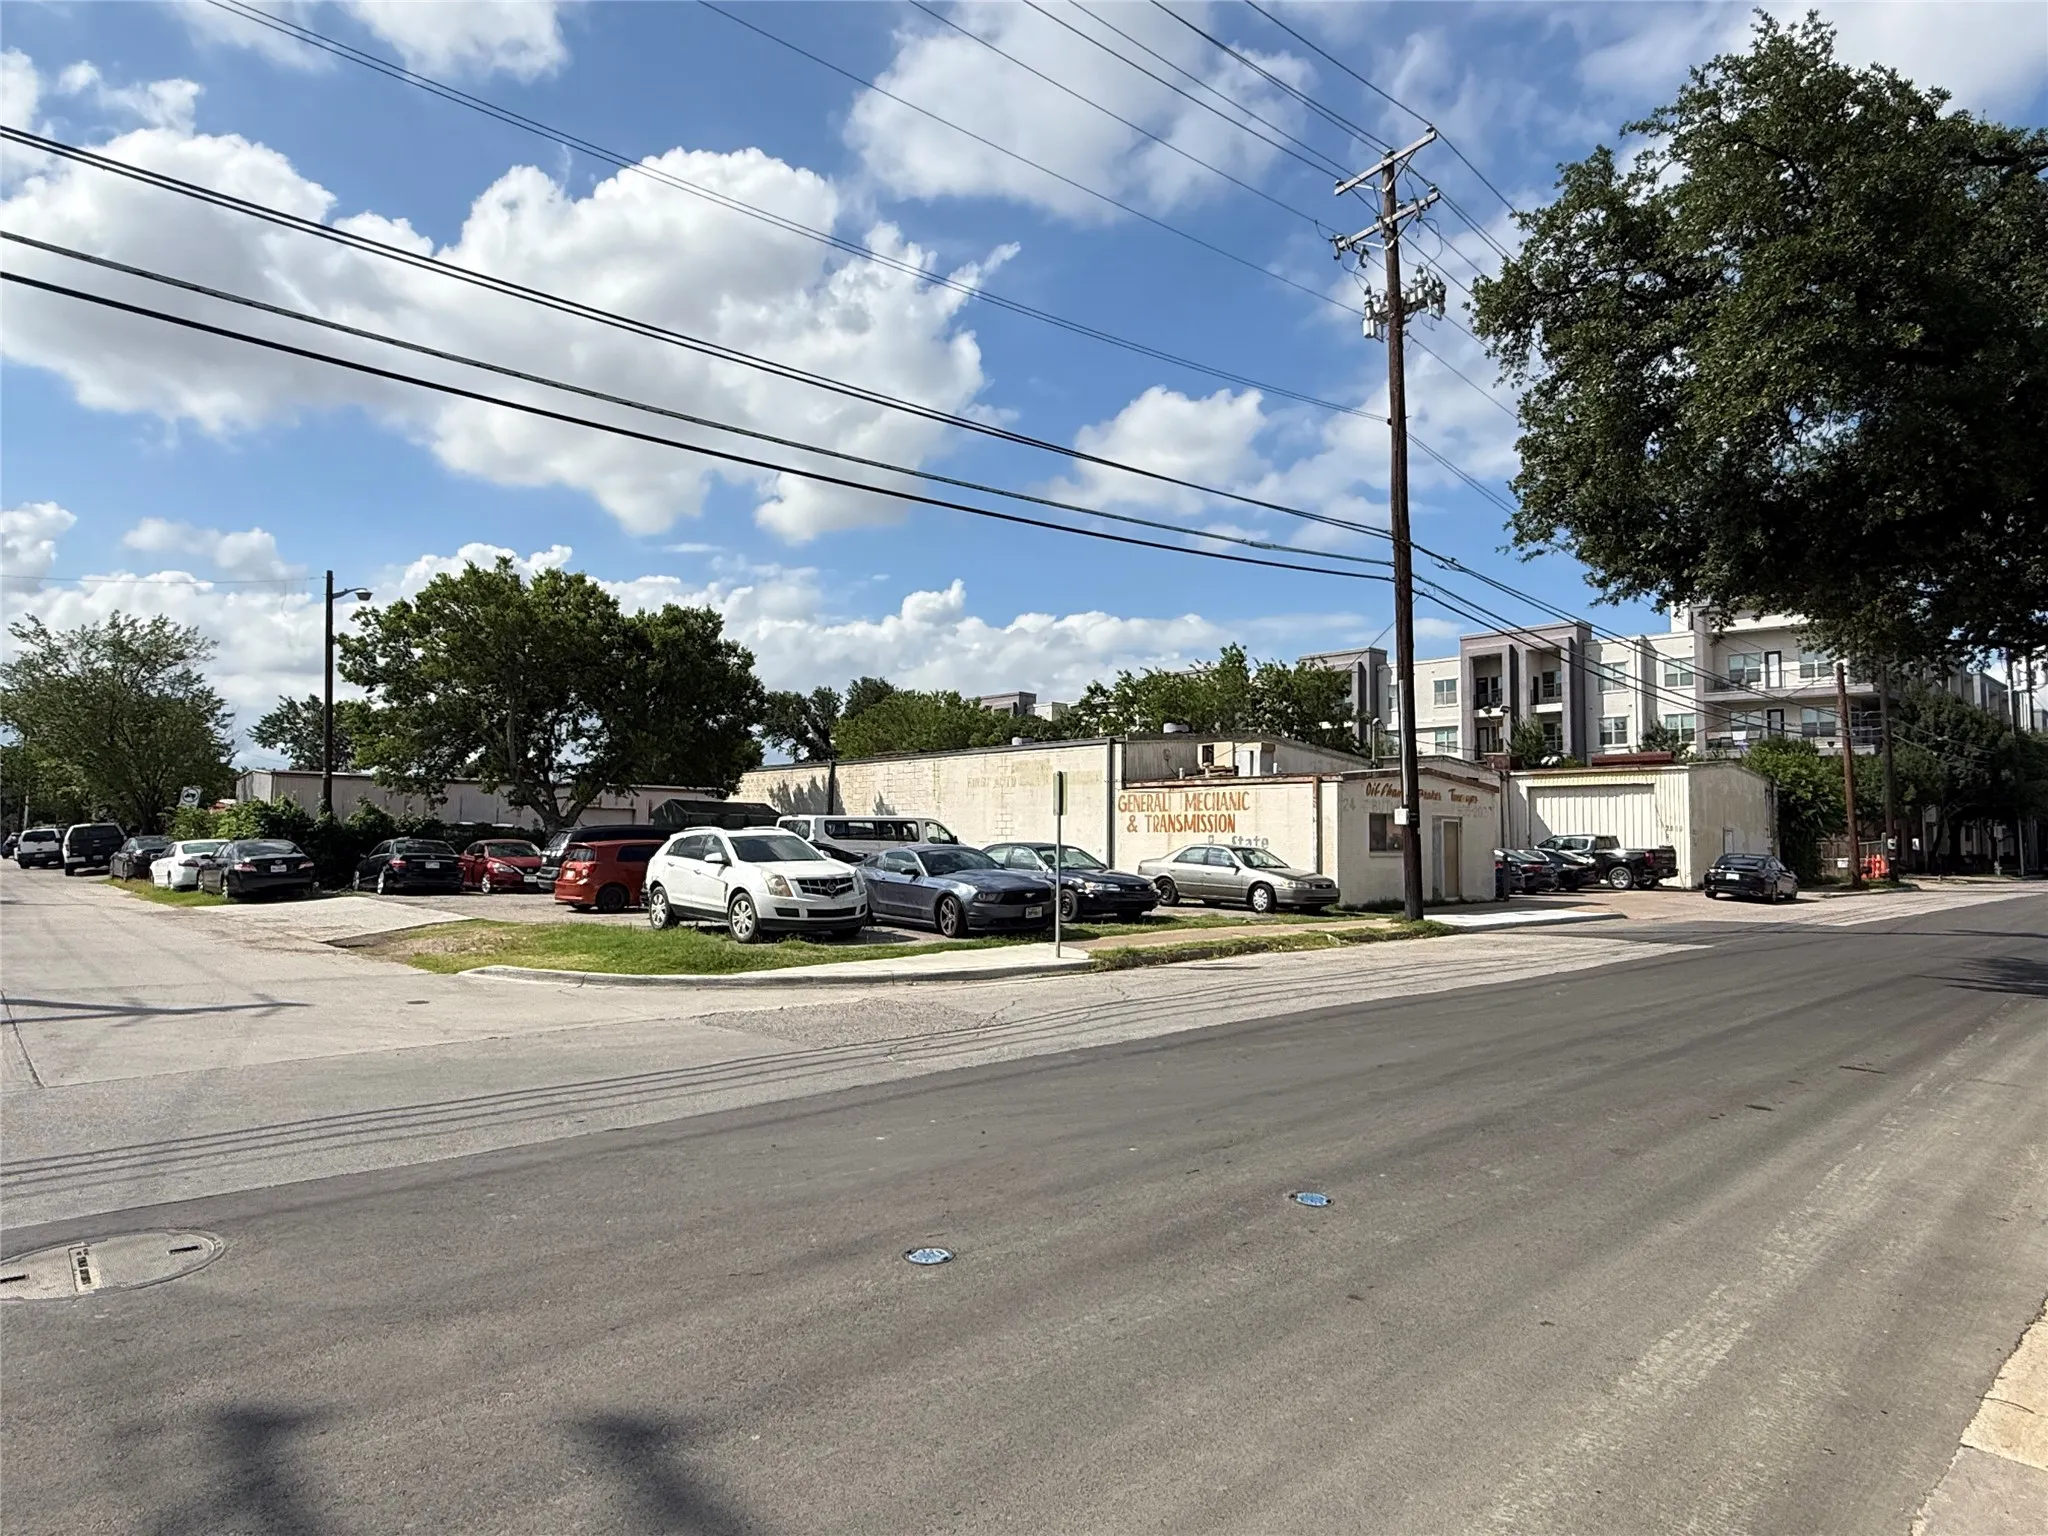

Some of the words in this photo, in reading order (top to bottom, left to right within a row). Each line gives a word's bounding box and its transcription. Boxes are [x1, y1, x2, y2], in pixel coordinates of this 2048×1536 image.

[1118, 793, 1169, 812] GENERAL
[1185, 791, 1250, 812] MECHANIC
[1126, 814, 1138, 833] &
[1144, 813, 1236, 833] TRANSMISSION
